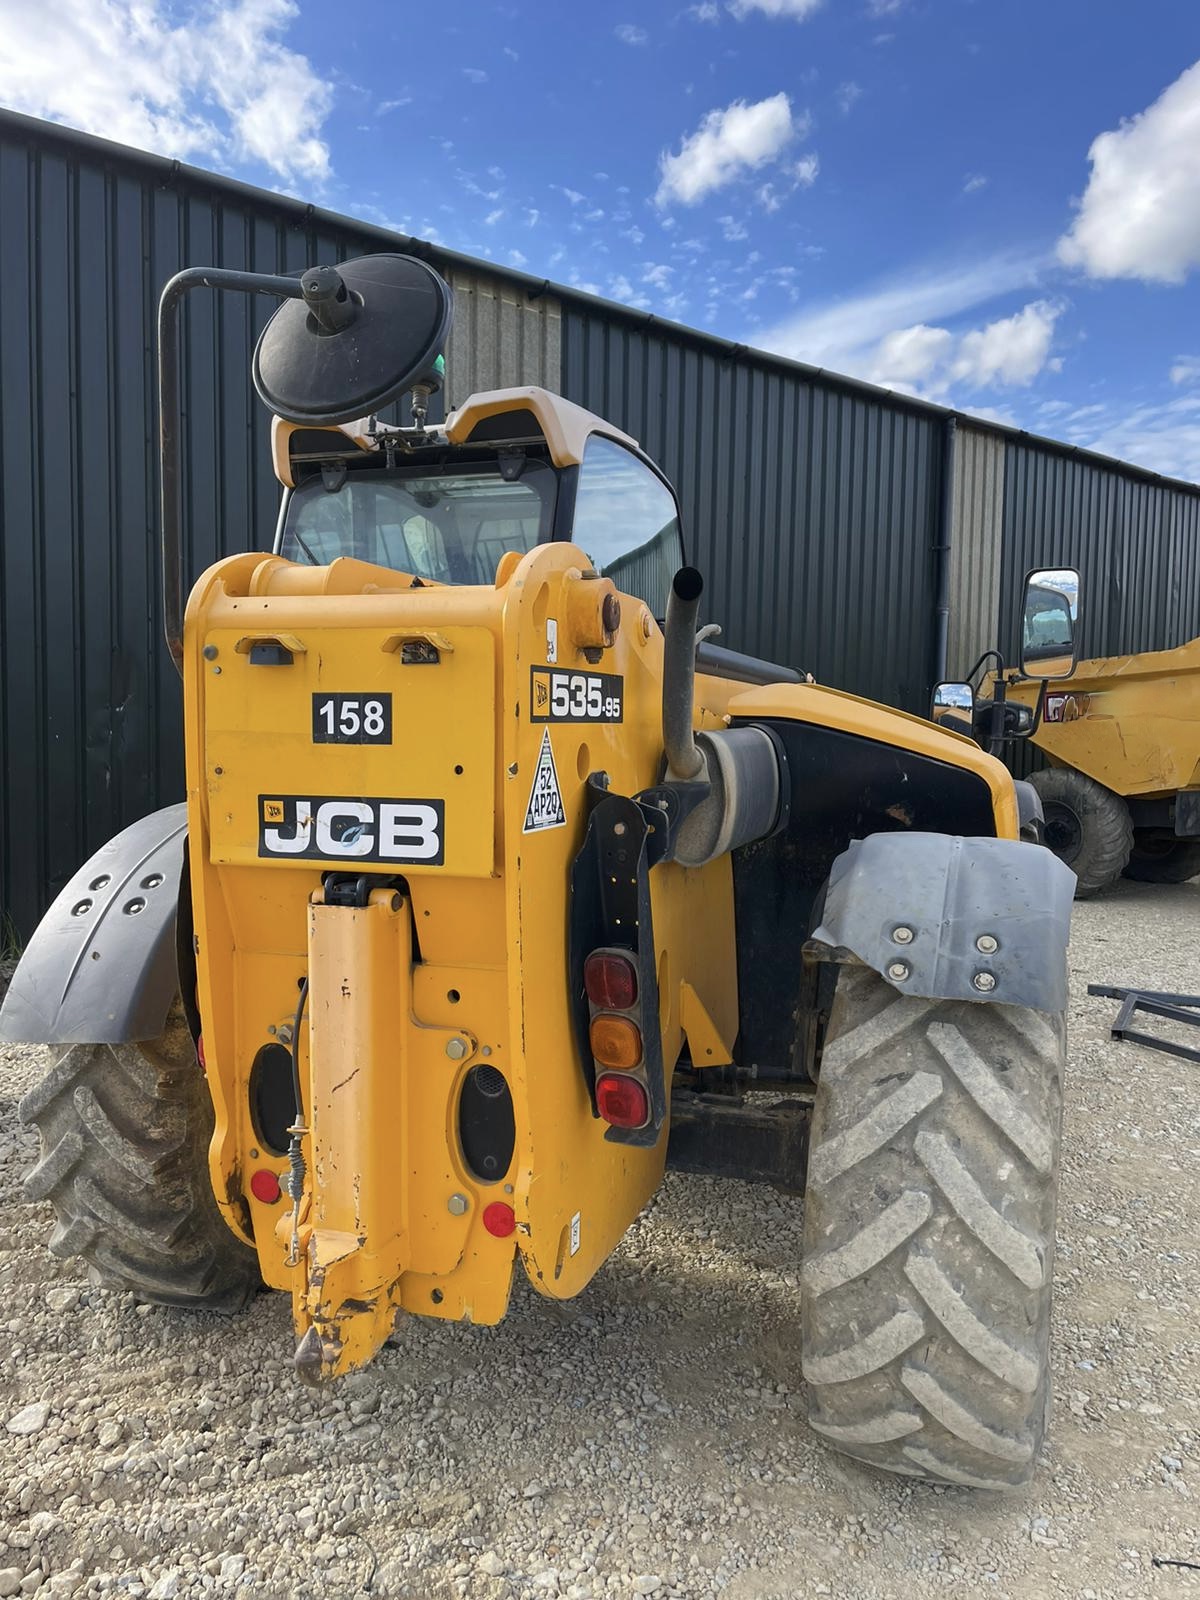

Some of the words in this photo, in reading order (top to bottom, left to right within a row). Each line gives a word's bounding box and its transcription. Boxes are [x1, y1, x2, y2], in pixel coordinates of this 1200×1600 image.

[319, 700, 384, 736] 158
[540, 766, 552, 791] 52
[264, 800, 440, 859] JCB
